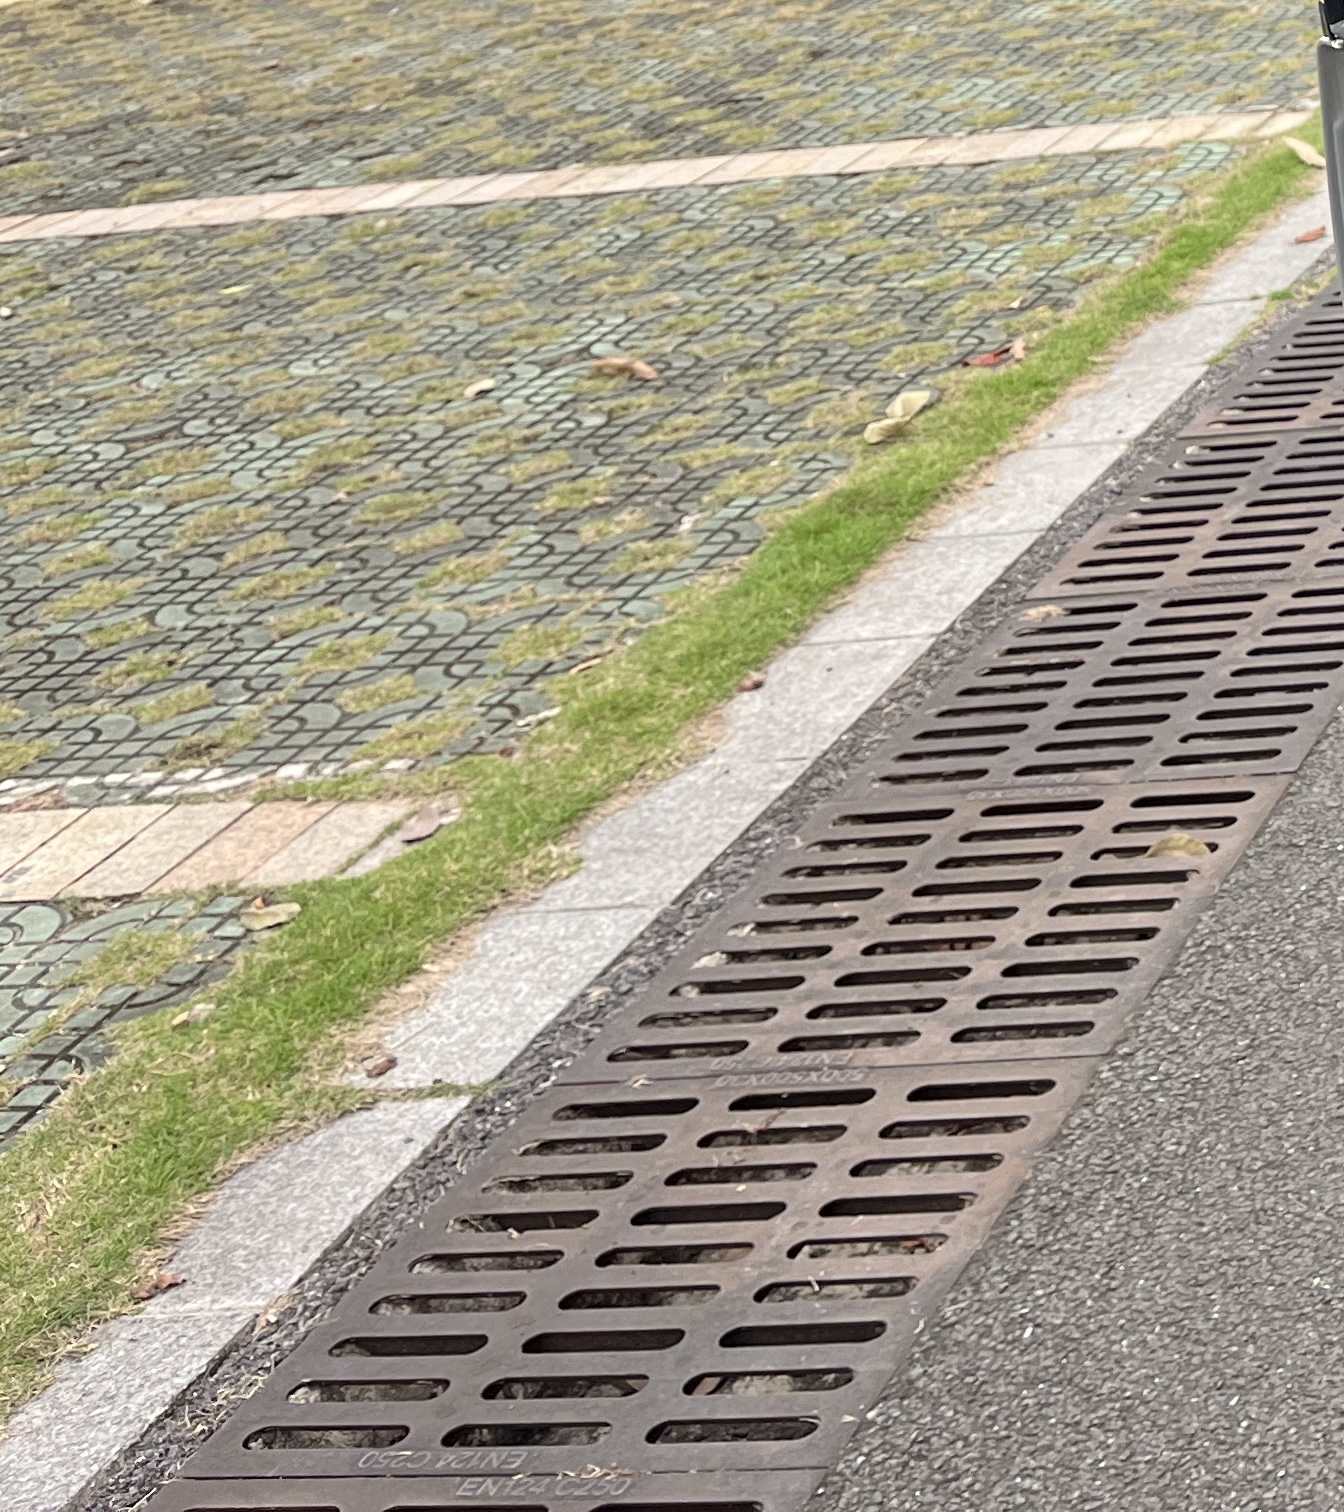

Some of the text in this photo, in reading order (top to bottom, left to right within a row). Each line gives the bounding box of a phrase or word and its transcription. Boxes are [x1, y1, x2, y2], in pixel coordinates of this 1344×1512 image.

[358, 1449, 529, 1470] EN124 C250
[454, 1476, 632, 1497] EN124 C250
